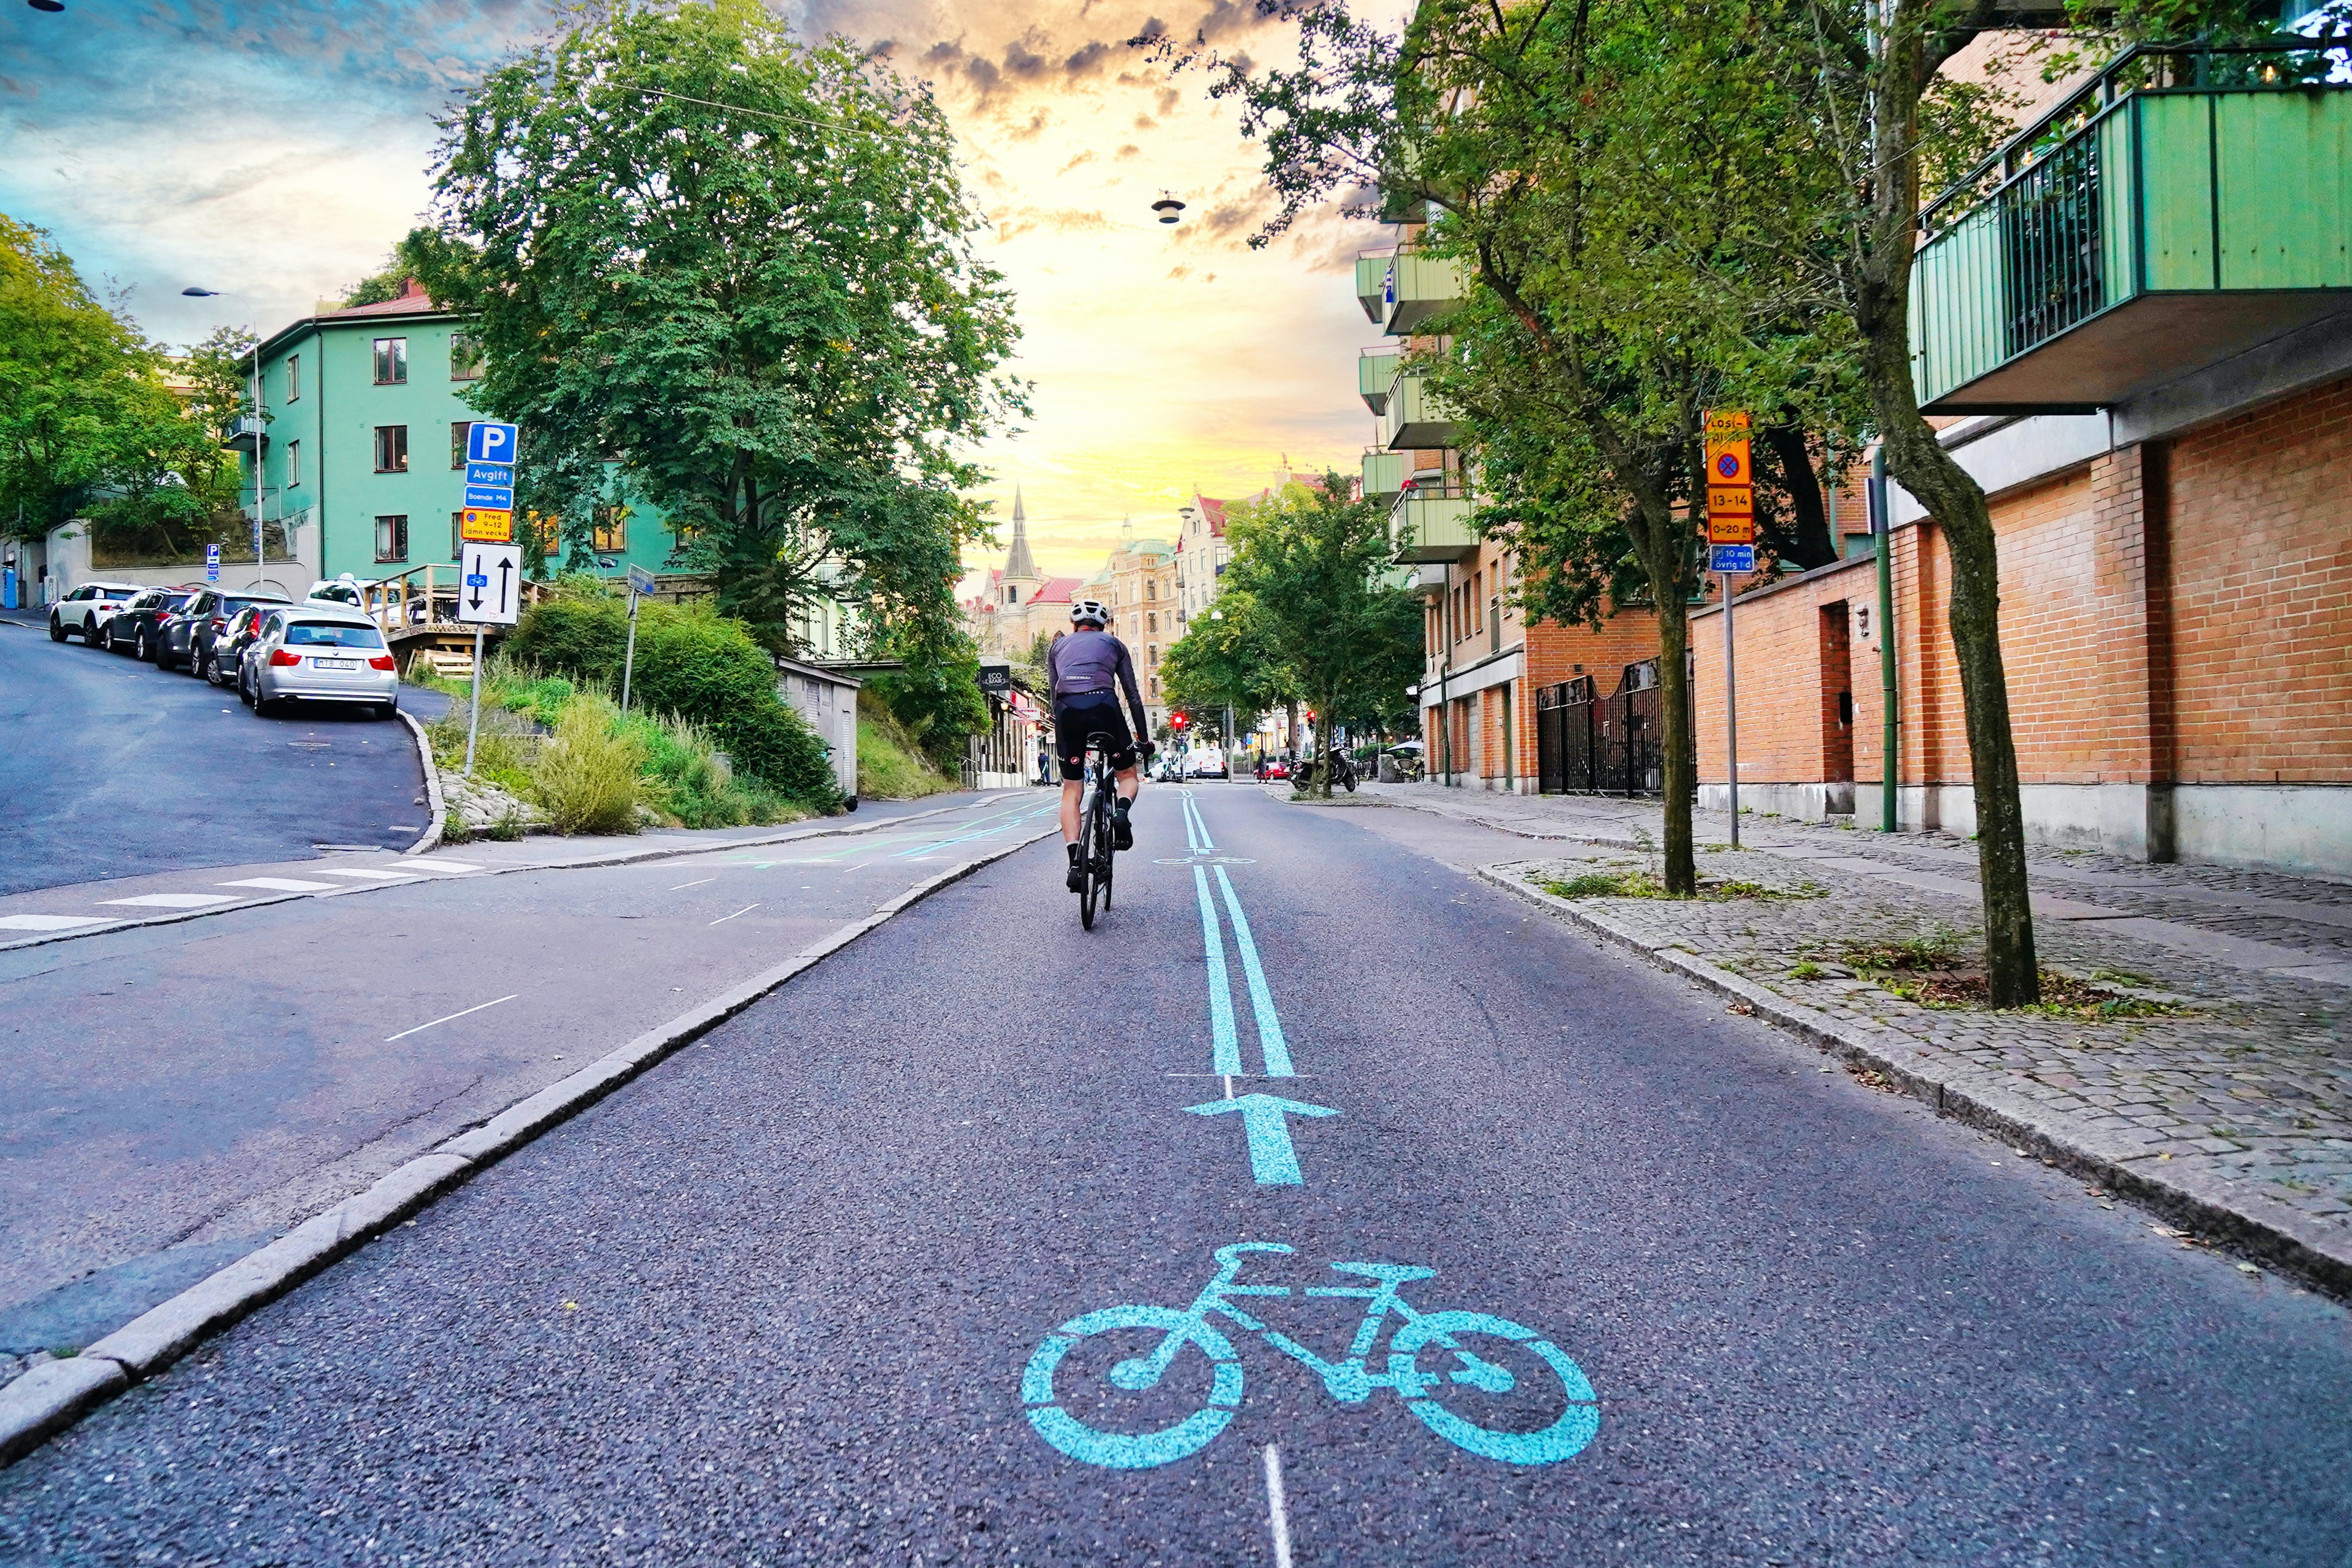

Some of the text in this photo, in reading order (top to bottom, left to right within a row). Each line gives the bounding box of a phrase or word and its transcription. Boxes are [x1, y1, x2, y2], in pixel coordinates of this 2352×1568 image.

[482, 426, 506, 459] P
[473, 469, 508, 482] Avgift
[1714, 495, 1748, 506] 13-14
[1714, 524, 1739, 534] 0-20
[210, 545, 218, 556] P
[1725, 550, 1735, 558] 10
[1738, 550, 1751, 558] min
[1715, 560, 1737, 570] övrig
